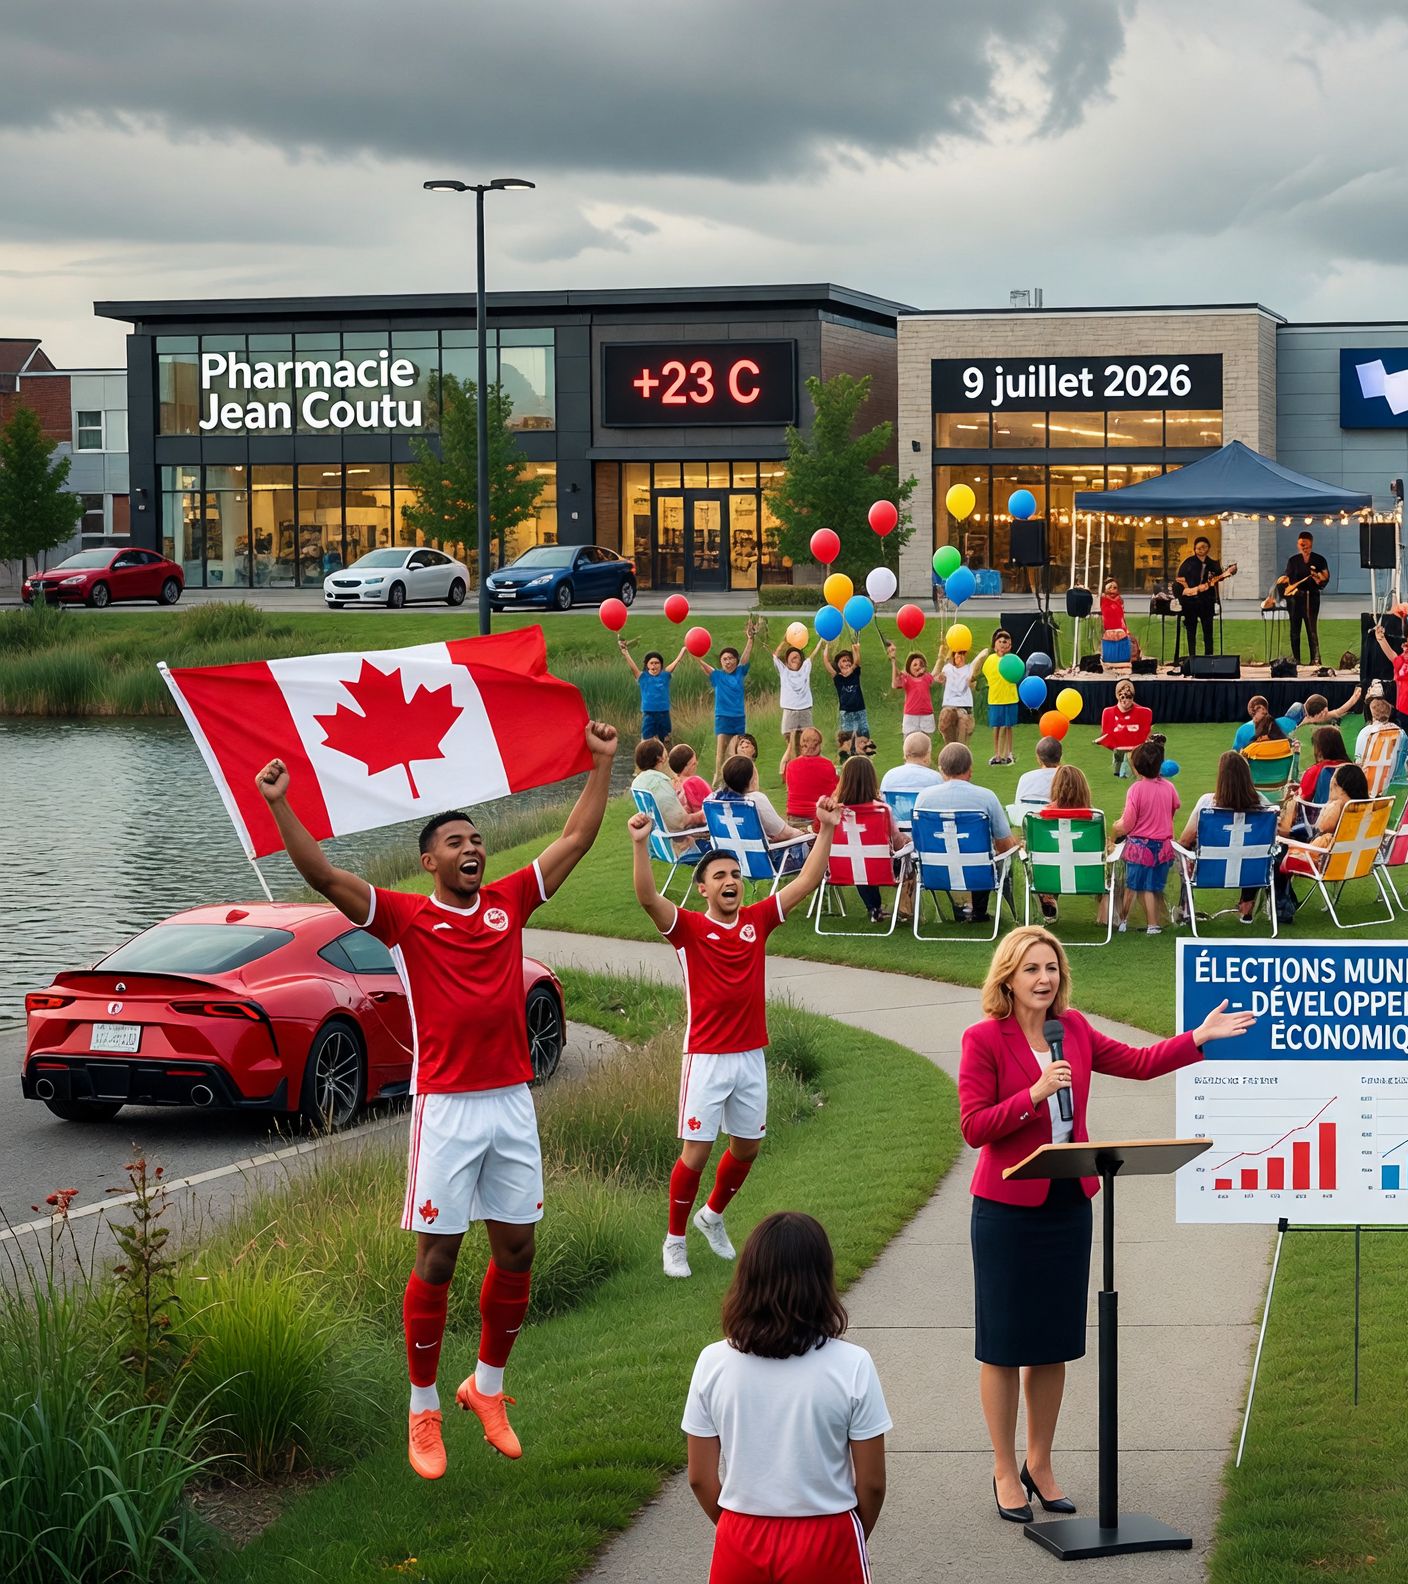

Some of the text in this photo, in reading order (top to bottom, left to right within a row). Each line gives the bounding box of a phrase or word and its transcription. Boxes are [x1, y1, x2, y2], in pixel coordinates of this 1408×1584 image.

[201, 350, 415, 390] Pharmacie
[633, 358, 761, 404] +23 C
[963, 363, 1192, 406] 9 juillet 2026
[199, 391, 422, 430] Jean Coutu
[1195, 950, 1336, 984] ÉLECTIONS
